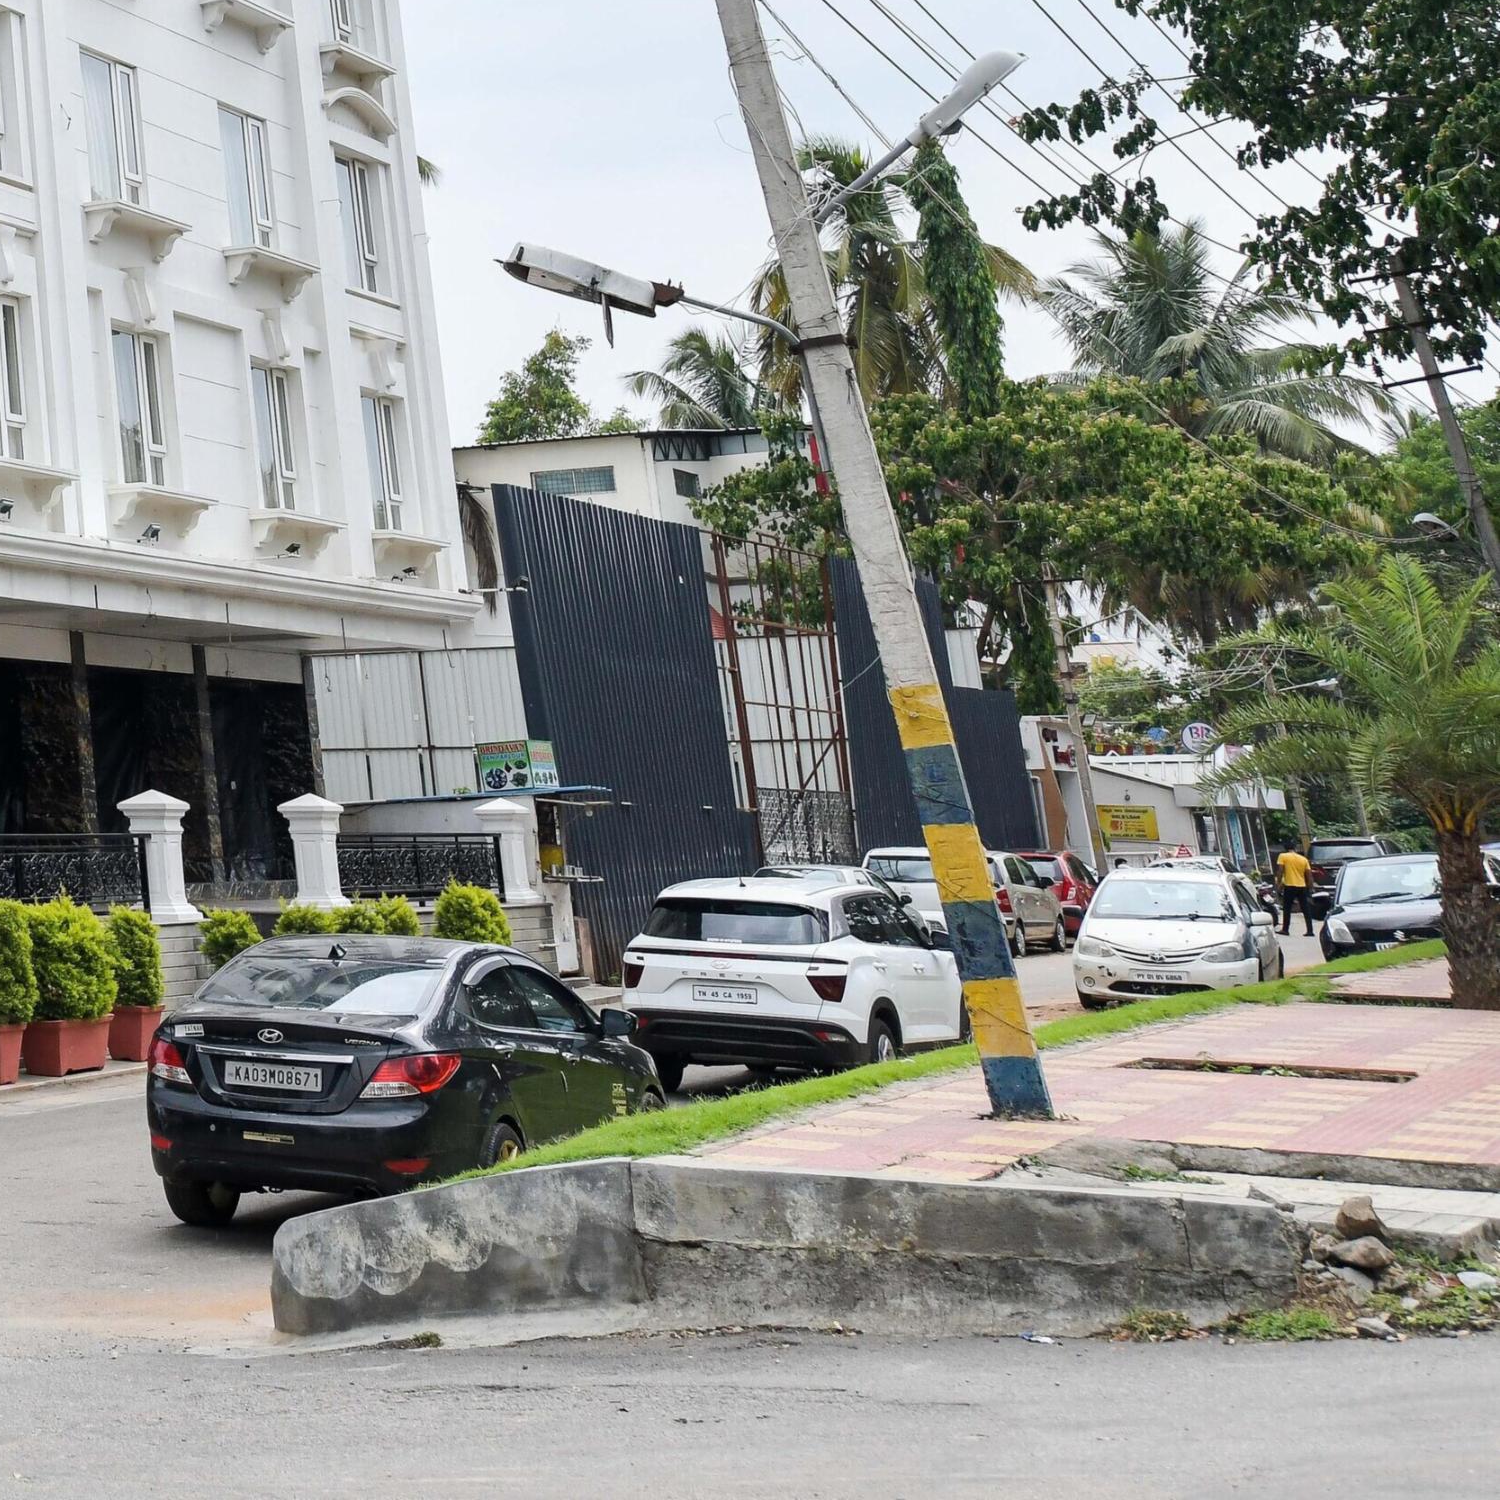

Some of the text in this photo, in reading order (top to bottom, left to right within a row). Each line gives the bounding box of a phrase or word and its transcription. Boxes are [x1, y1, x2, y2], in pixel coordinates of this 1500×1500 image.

[682, 971, 763, 980] CRETA
[344, 1038, 382, 1046] VERNA
[234, 1066, 319, 1088] KA03MQ8671
